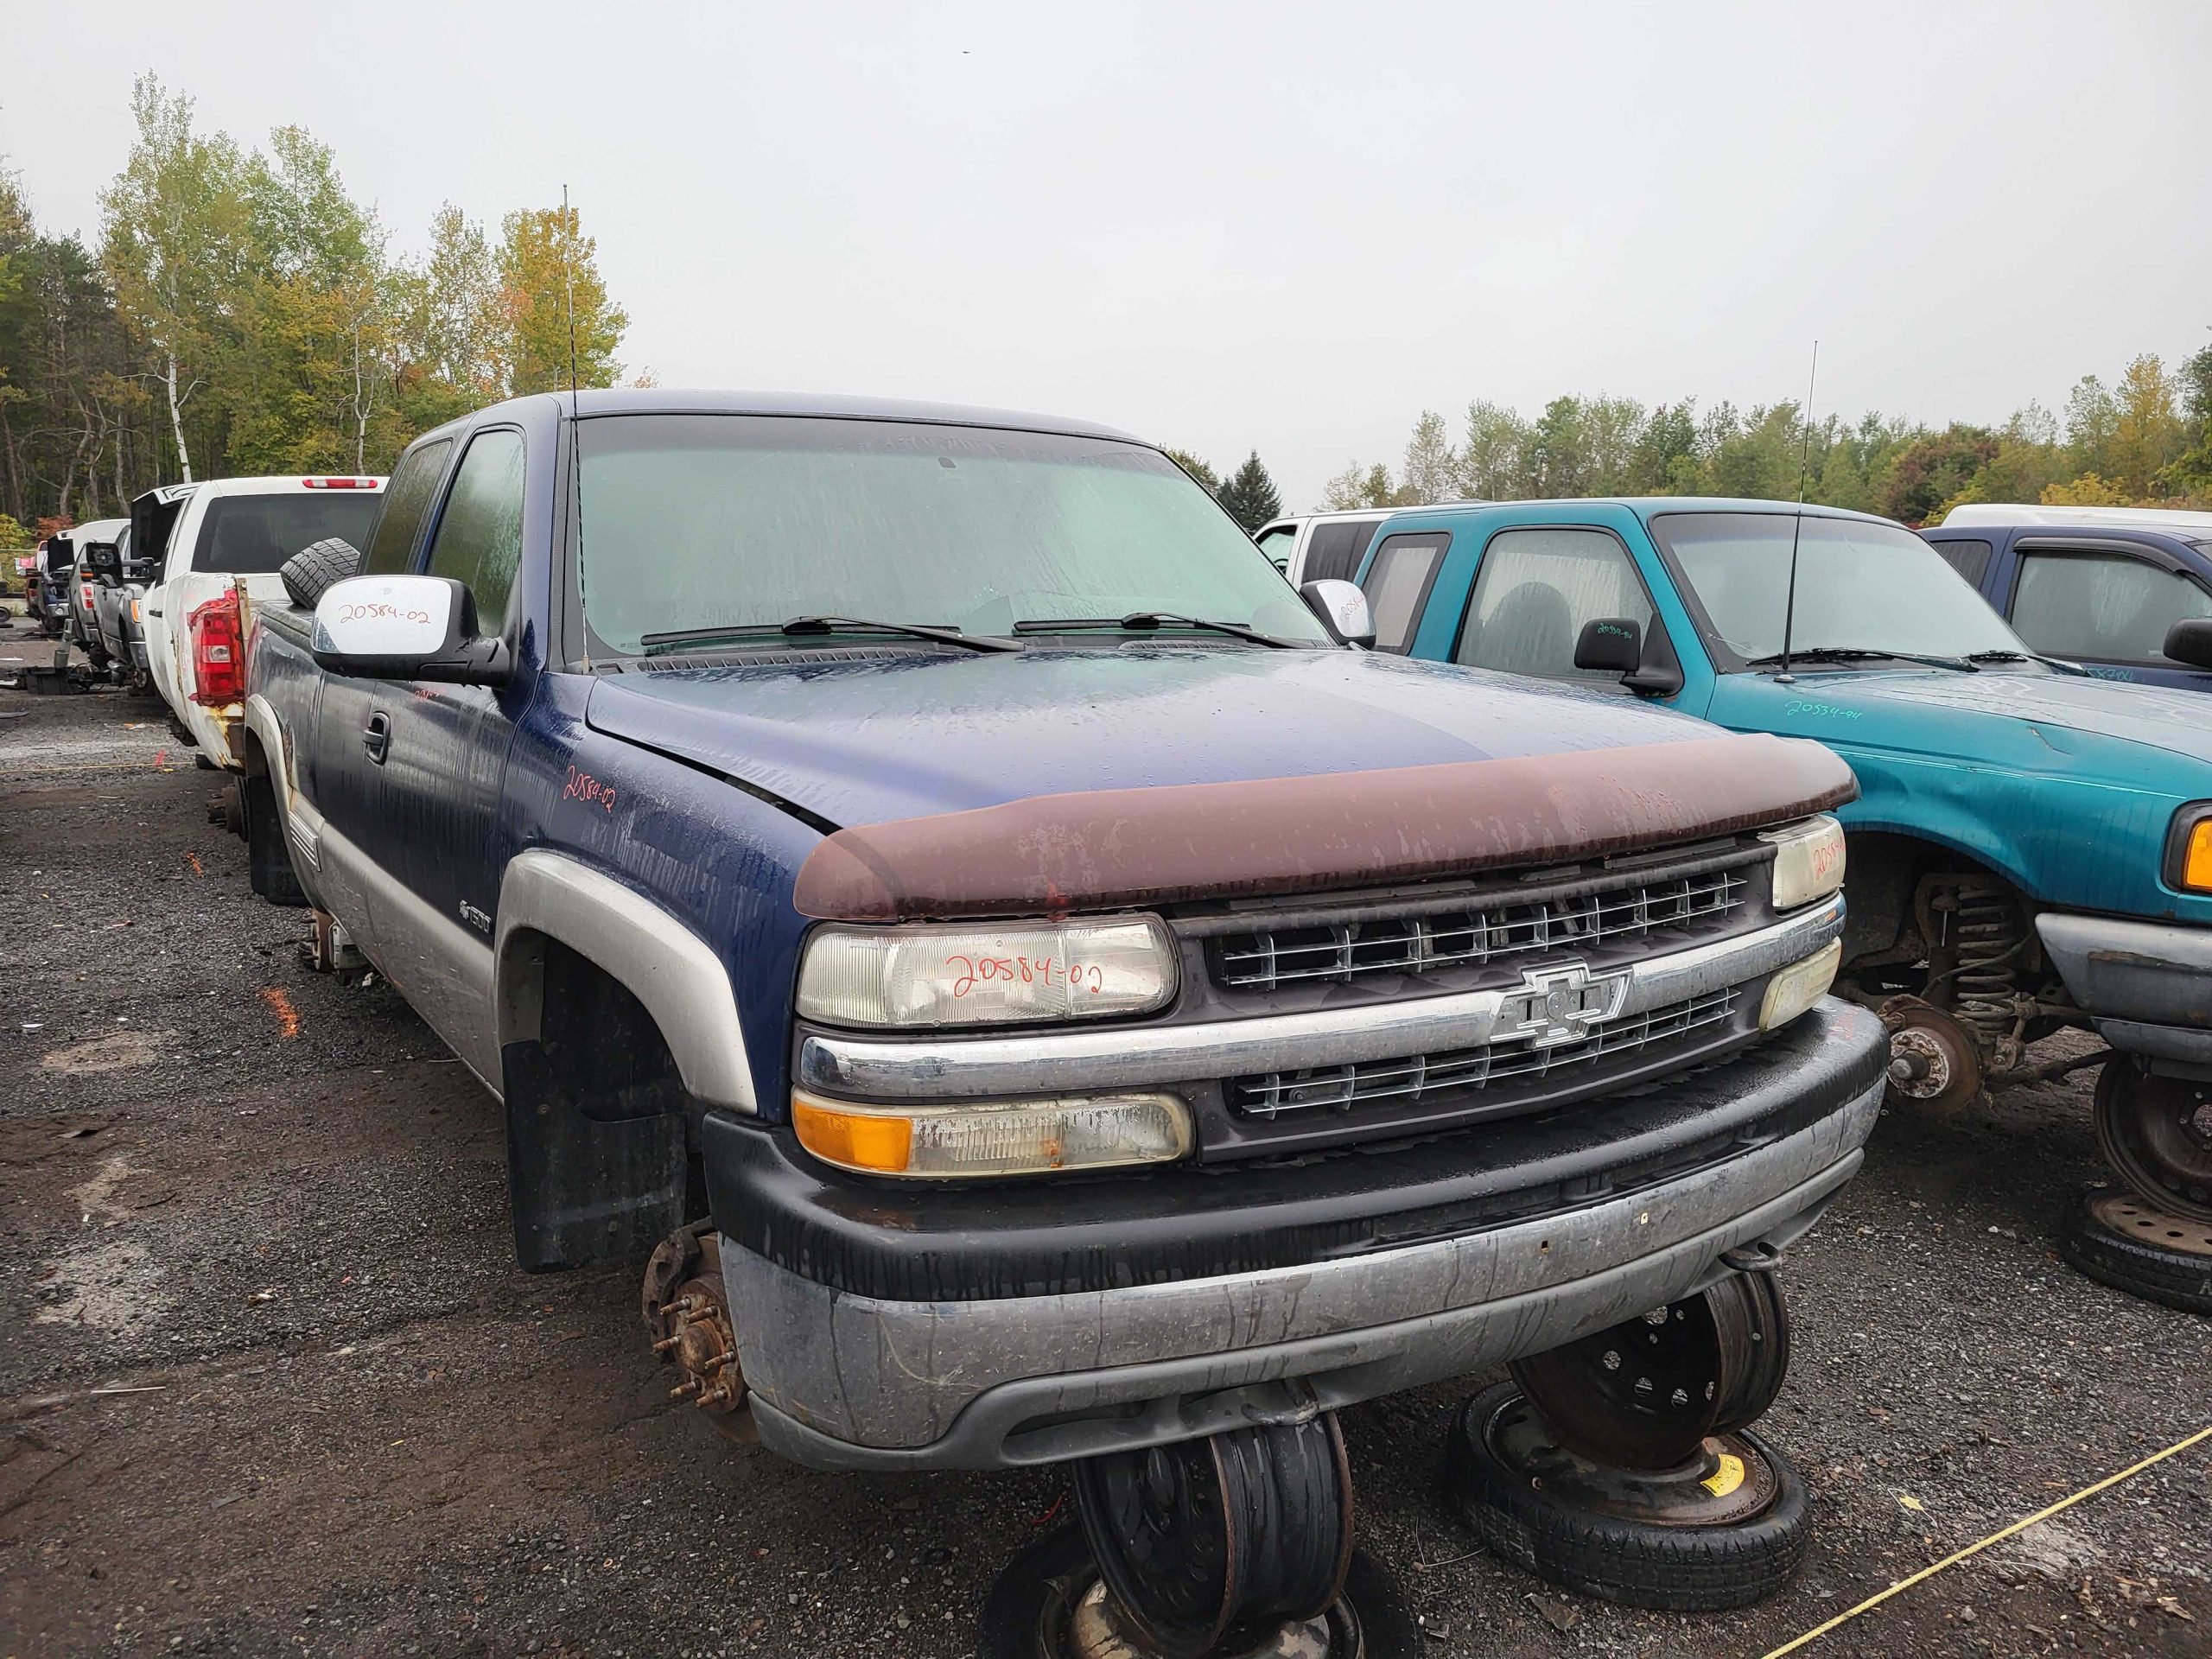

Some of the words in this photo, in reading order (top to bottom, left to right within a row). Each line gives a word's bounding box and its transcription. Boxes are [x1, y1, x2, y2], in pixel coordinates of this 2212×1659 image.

[338, 603, 431, 625] 20584-02
[563, 765, 617, 814] 20584-02
[945, 955, 1103, 998] 20584-02
